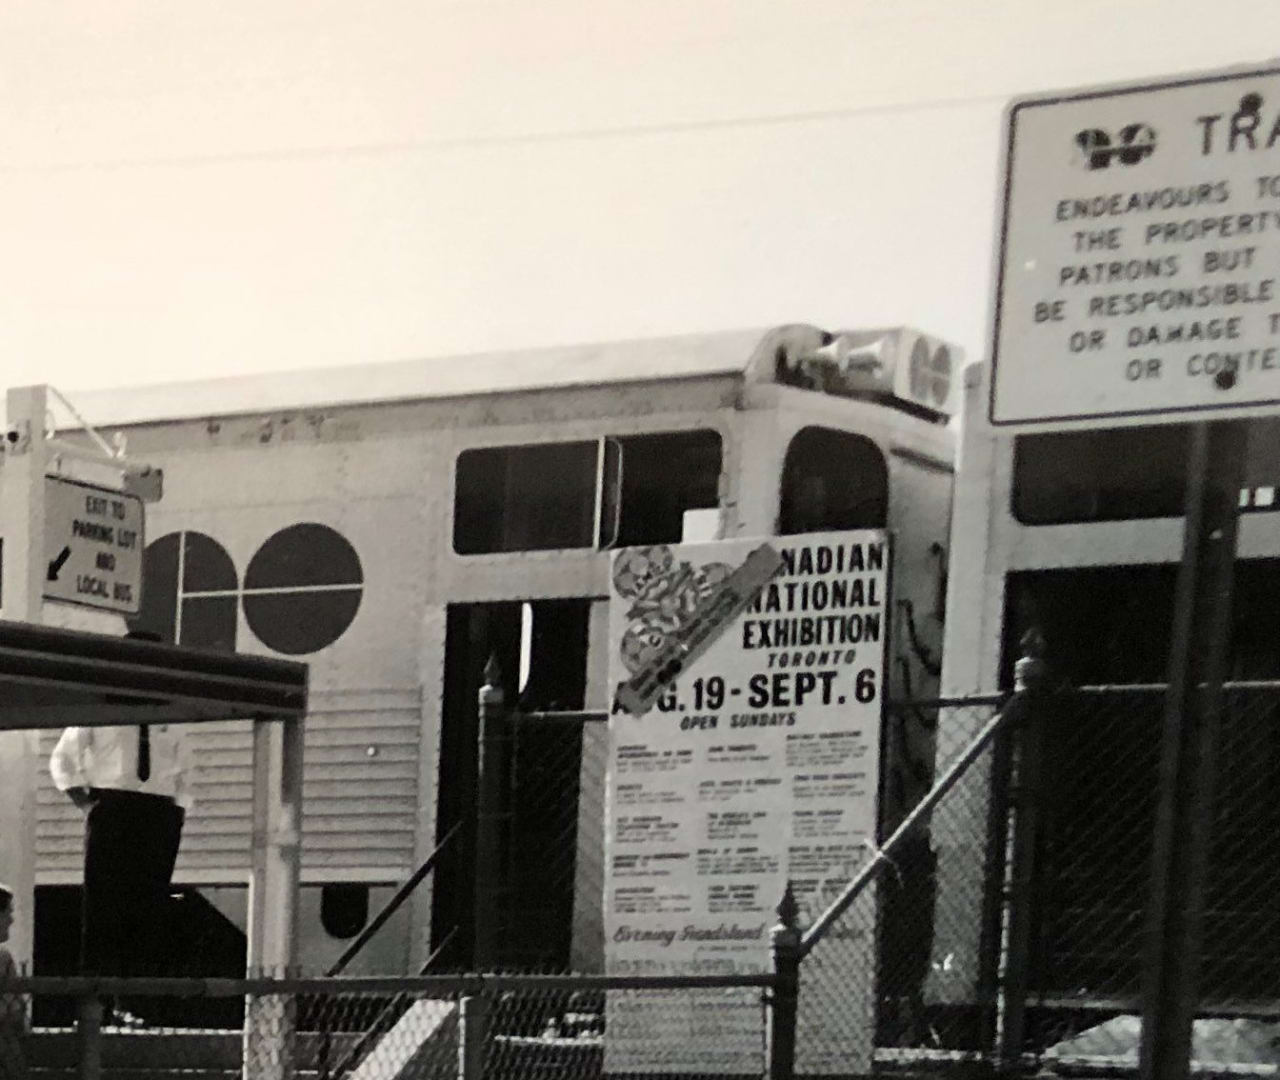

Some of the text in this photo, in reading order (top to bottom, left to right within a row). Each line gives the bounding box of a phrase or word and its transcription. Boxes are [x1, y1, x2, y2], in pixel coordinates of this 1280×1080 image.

[1056, 179, 1230, 222] ENDEAVOURS
[1072, 227, 1123, 253] THE
[1059, 246, 1256, 288] PATRONS BUT
[1033, 278, 1275, 324] BE RESPONSIBLE
[1069, 329, 1106, 353] OR
[1126, 316, 1242, 349] DAMAGE
[1126, 357, 1163, 382] OR
[77, 573, 110, 599] LOCAL
[742, 612, 881, 650] EXHIBITION
[767, 649, 857, 669] TORONTO
[693, 675, 725, 711] 19
[748, 670, 847, 710] SEPT.
[854, 668, 878, 705] 6
[680, 710, 797, 731] OPEN SUNDAYS
[612, 924, 676, 947] Evening
